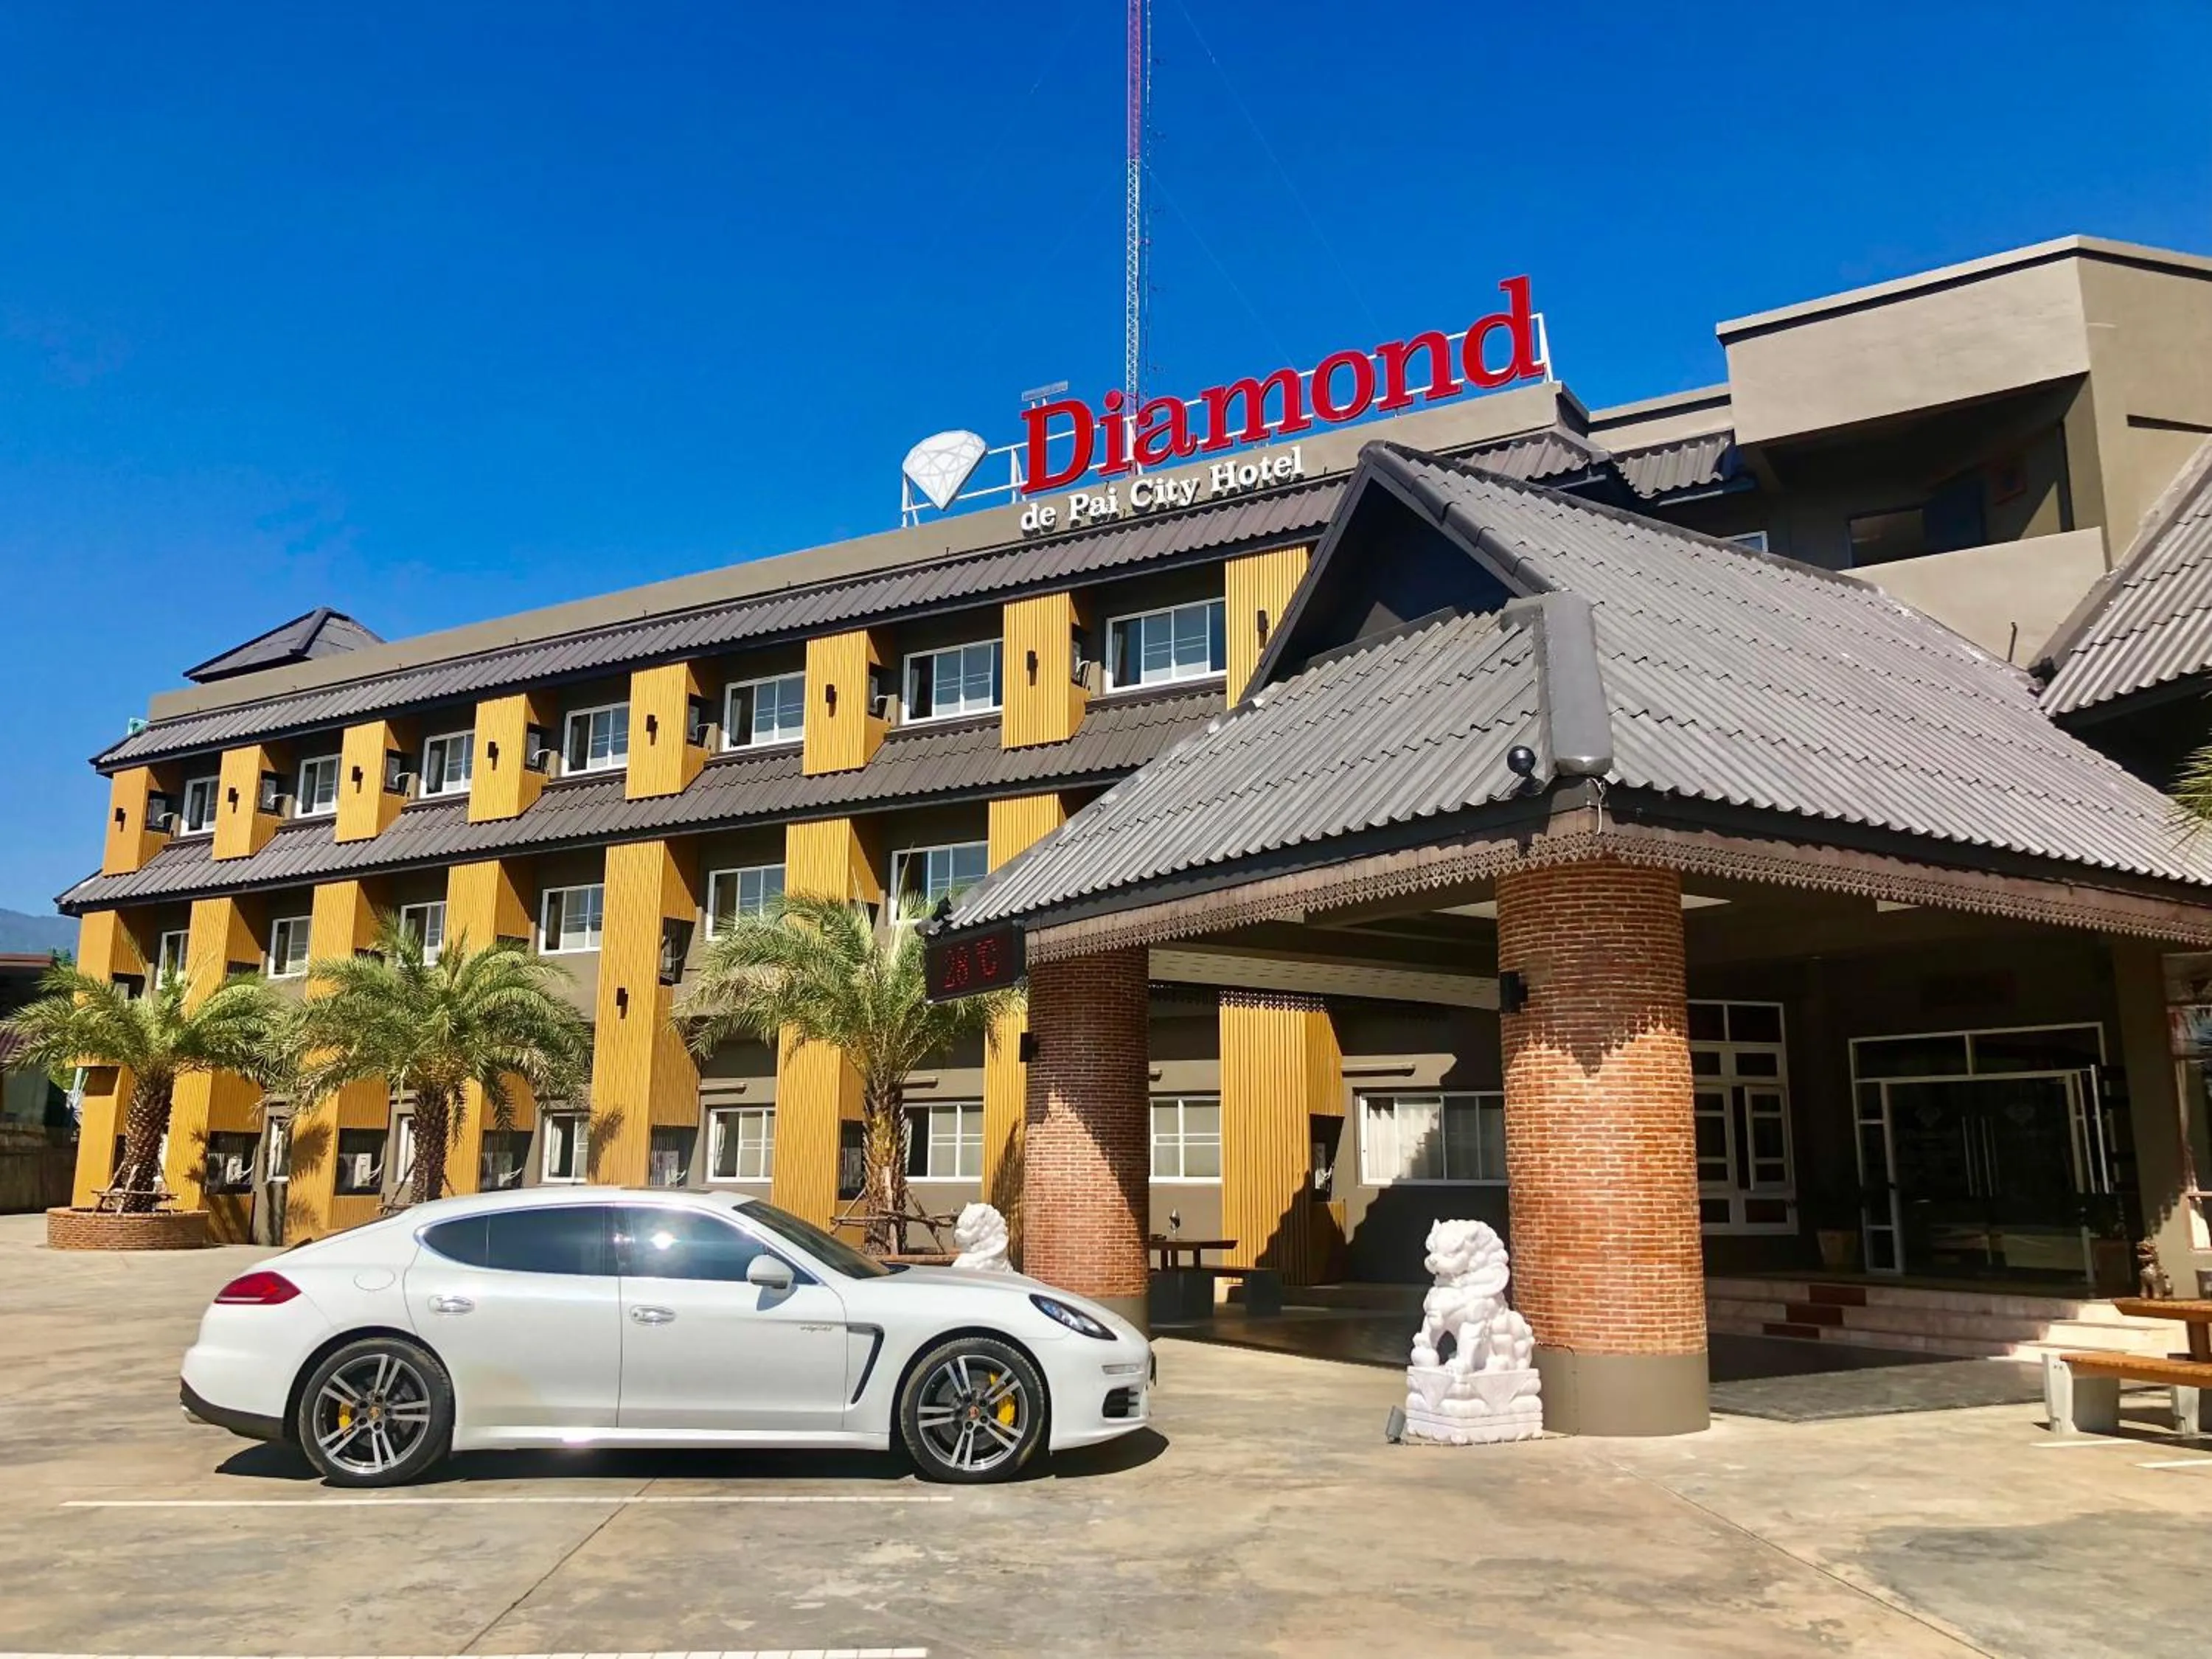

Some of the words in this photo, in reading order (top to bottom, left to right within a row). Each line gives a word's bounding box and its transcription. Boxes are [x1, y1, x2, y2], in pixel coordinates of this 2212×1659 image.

[1020, 274, 1545, 495] Diamond
[1020, 501, 1057, 532] de
[1068, 487, 1119, 523] Pai
[1130, 477, 1200, 507] City
[1208, 445, 1305, 493] Hotel
